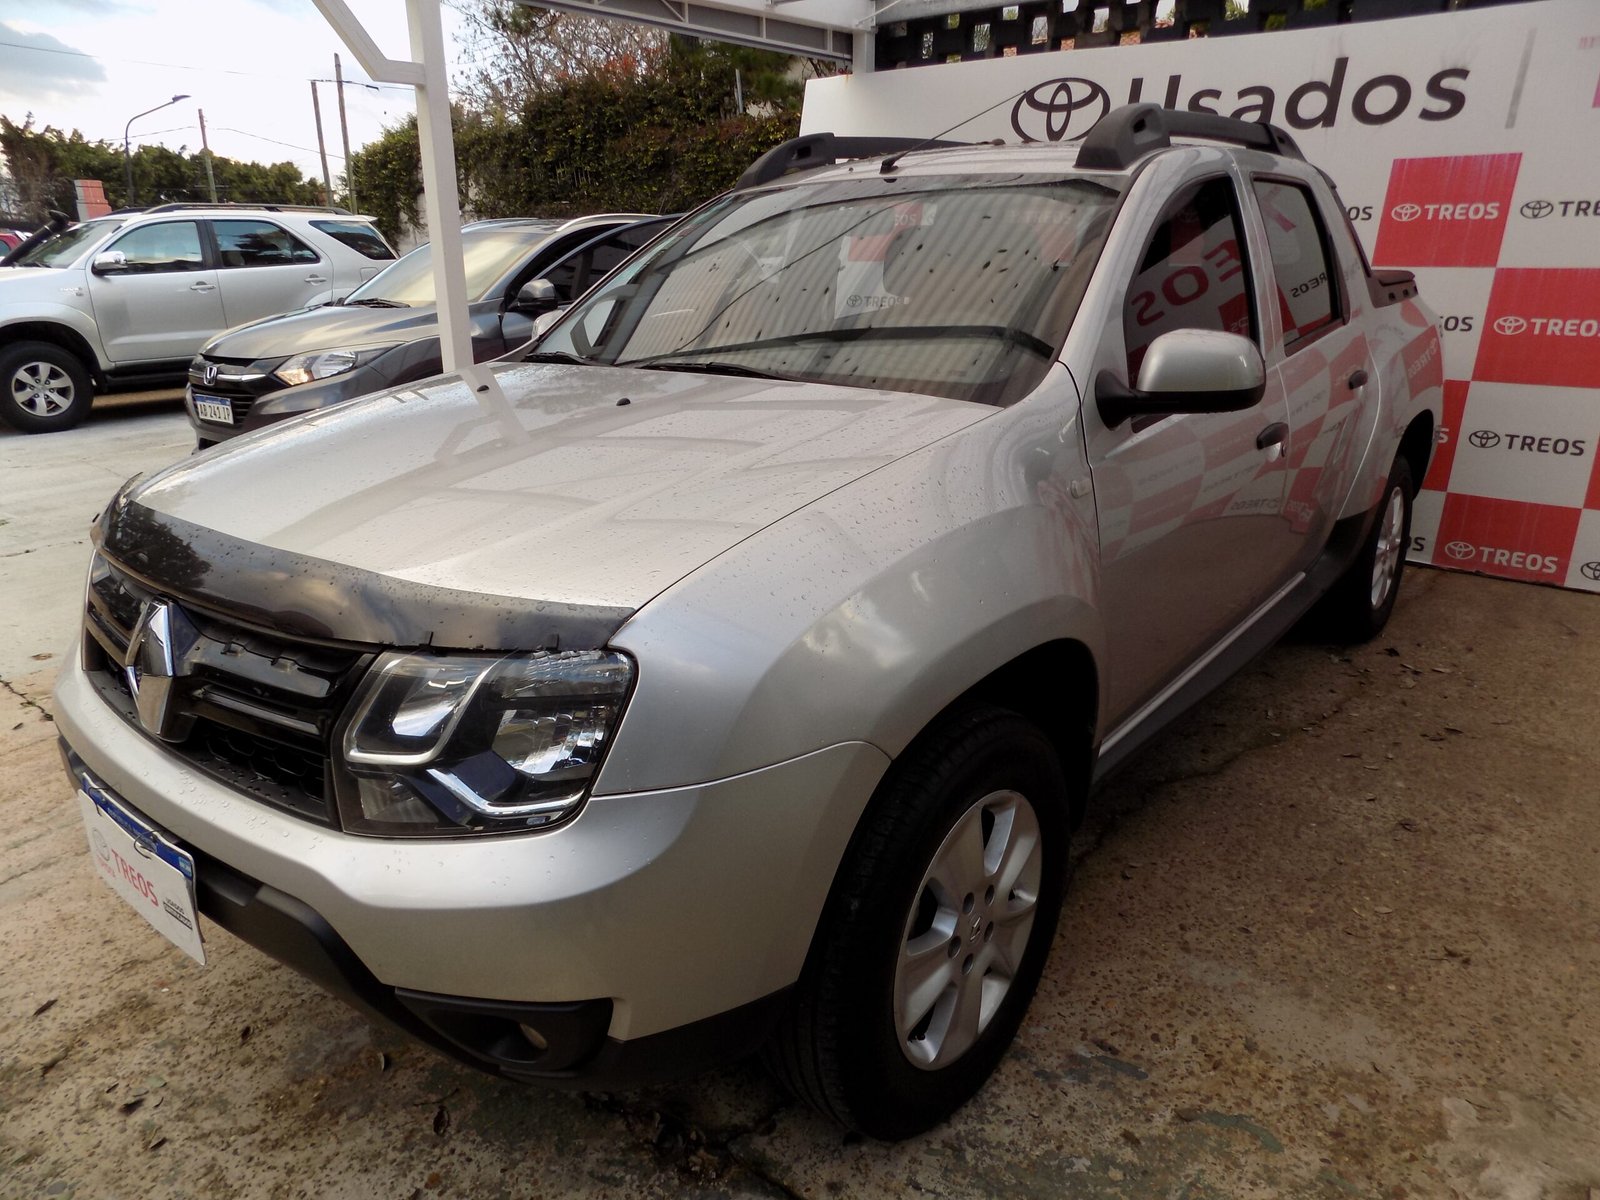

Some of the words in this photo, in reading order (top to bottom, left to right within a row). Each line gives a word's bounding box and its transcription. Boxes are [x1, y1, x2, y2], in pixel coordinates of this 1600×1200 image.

[1424, 202, 1500, 221] TREOS
[1530, 318, 1600, 338] TREO
[1505, 433, 1586, 457] TREOS
[1479, 546, 1559, 574] TREOS
[111, 848, 159, 907] TREOS
